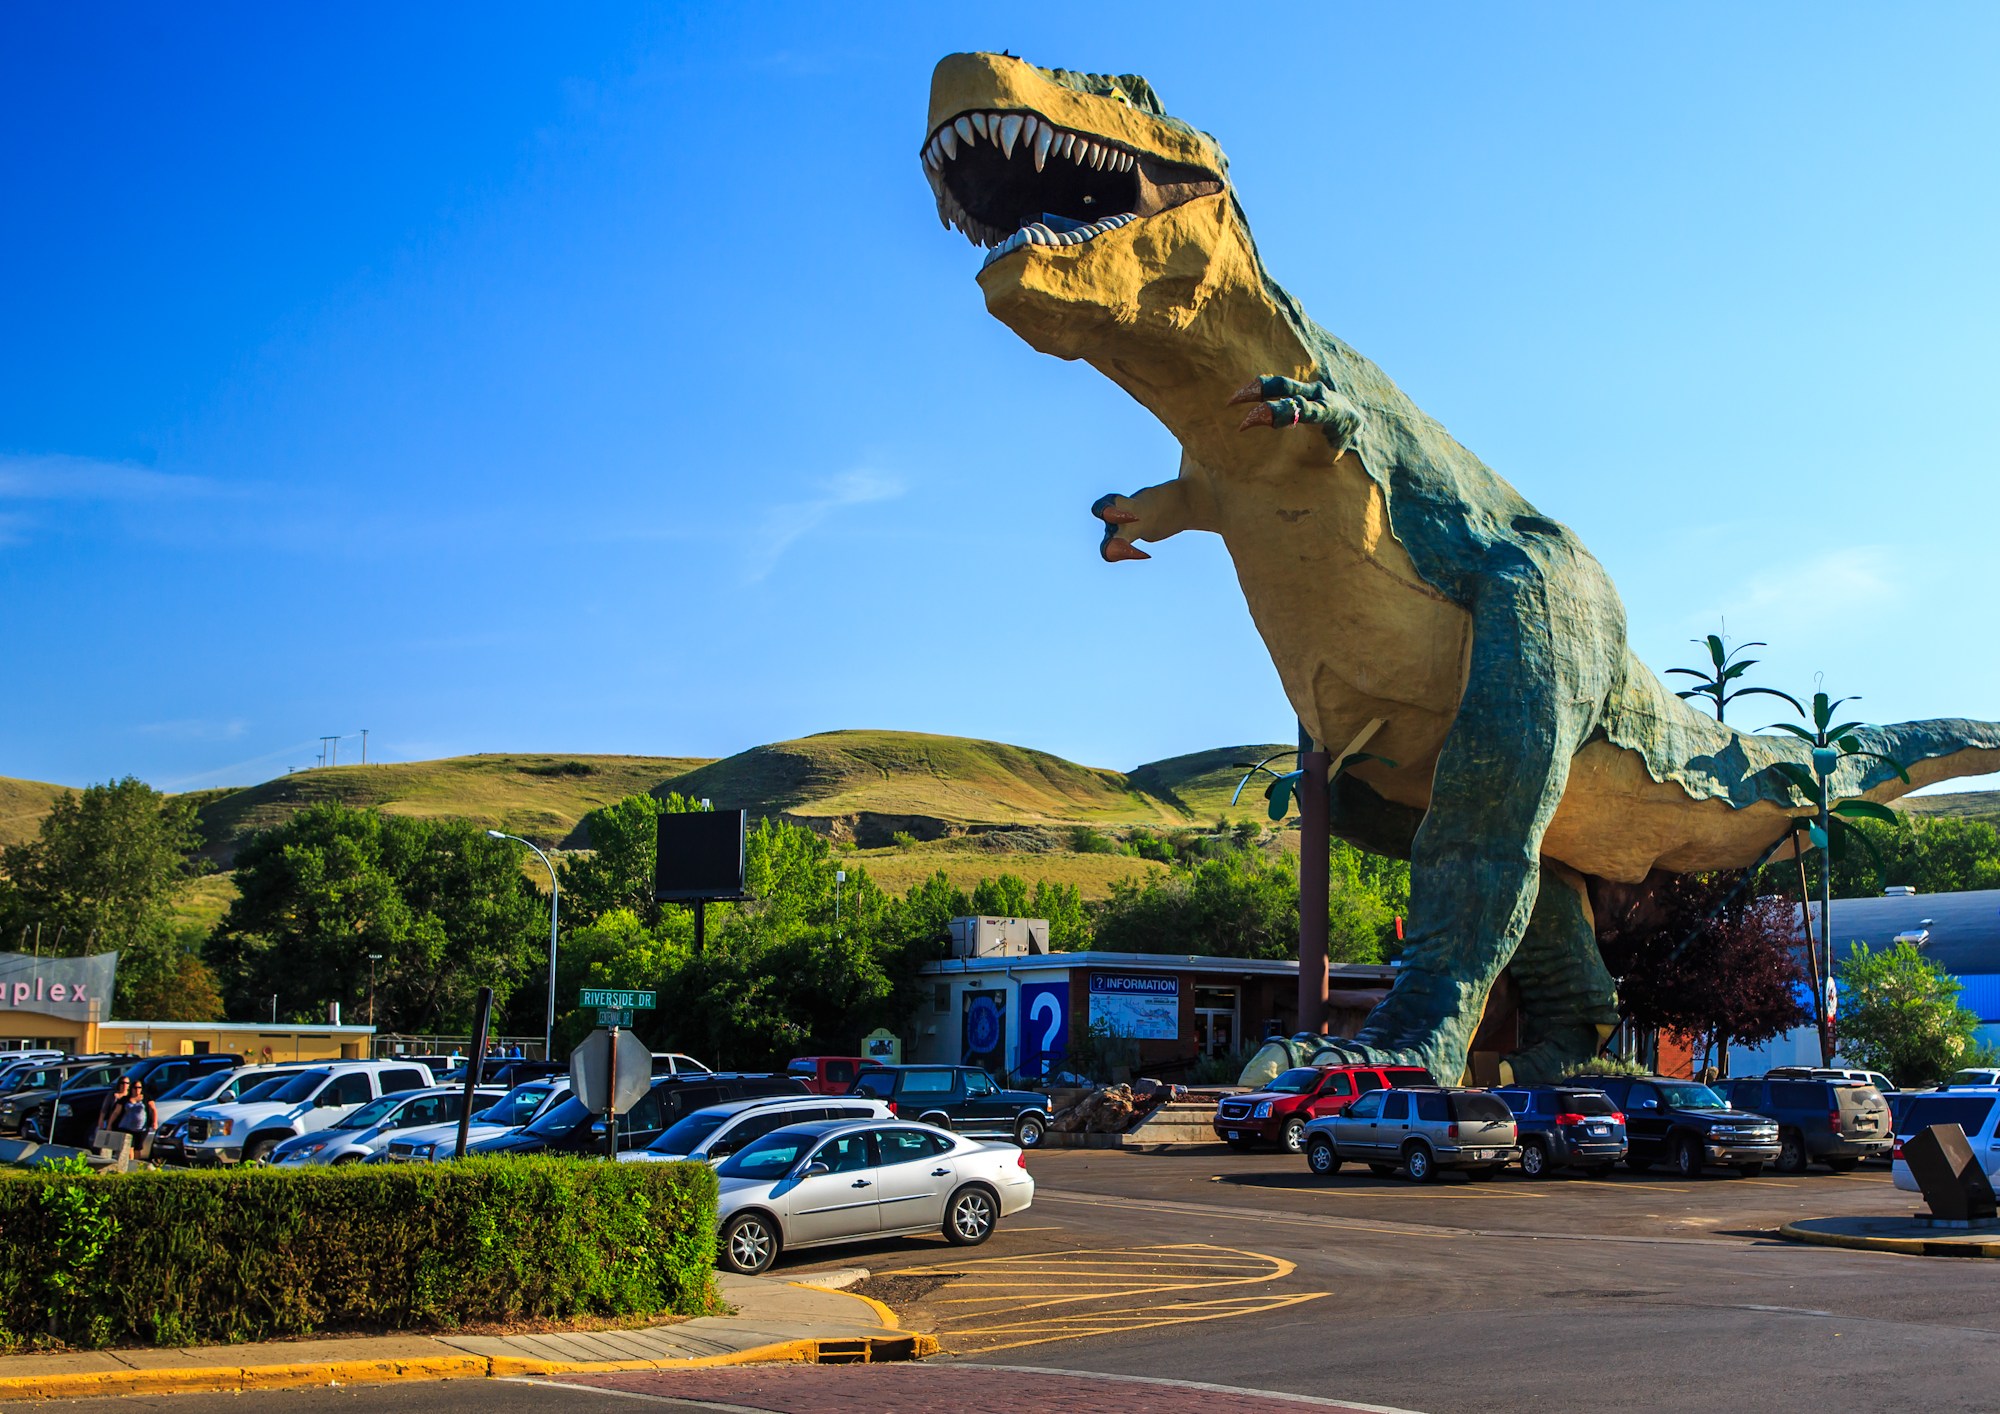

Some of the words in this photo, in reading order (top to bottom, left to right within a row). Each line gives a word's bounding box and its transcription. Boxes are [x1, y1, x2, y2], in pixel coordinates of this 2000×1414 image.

[1106, 978, 1176, 992] INFORMATION
[584, 991, 634, 1006] RIVERSIDE
[638, 993, 652, 1007] DR
